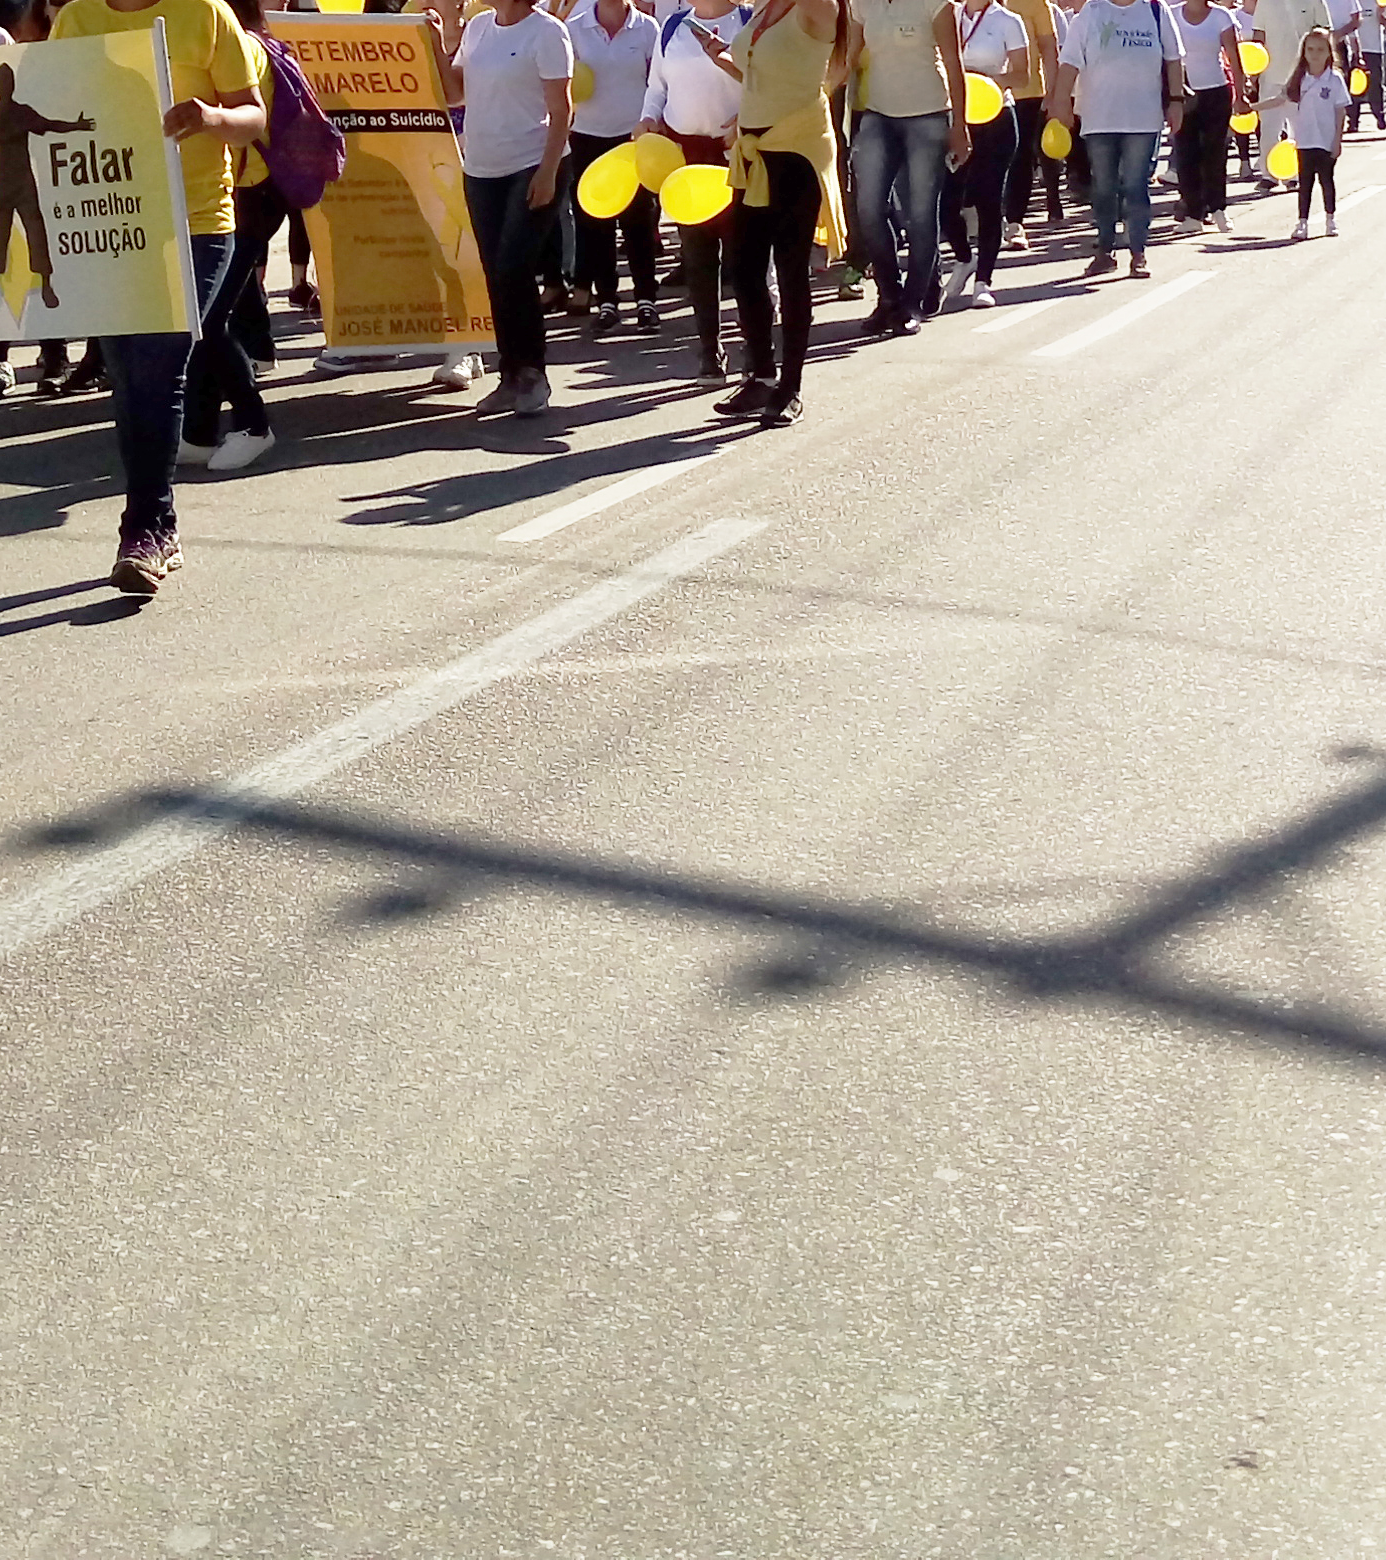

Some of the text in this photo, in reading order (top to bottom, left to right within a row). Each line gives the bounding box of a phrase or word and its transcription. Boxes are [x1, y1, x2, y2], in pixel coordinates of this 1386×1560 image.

[285, 40, 416, 63] SETEMBRO
[370, 115, 387, 127] ao
[390, 112, 446, 127] Suicídio
[49, 139, 134, 187] Falar
[53, 192, 142, 219] é a melhor
[57, 222, 147, 259] SOLUÇÃO
[335, 303, 386, 316] UNIDADE
[389, 302, 405, 314] DE
[339, 315, 493, 337] JOSÉ MANOEL RE
